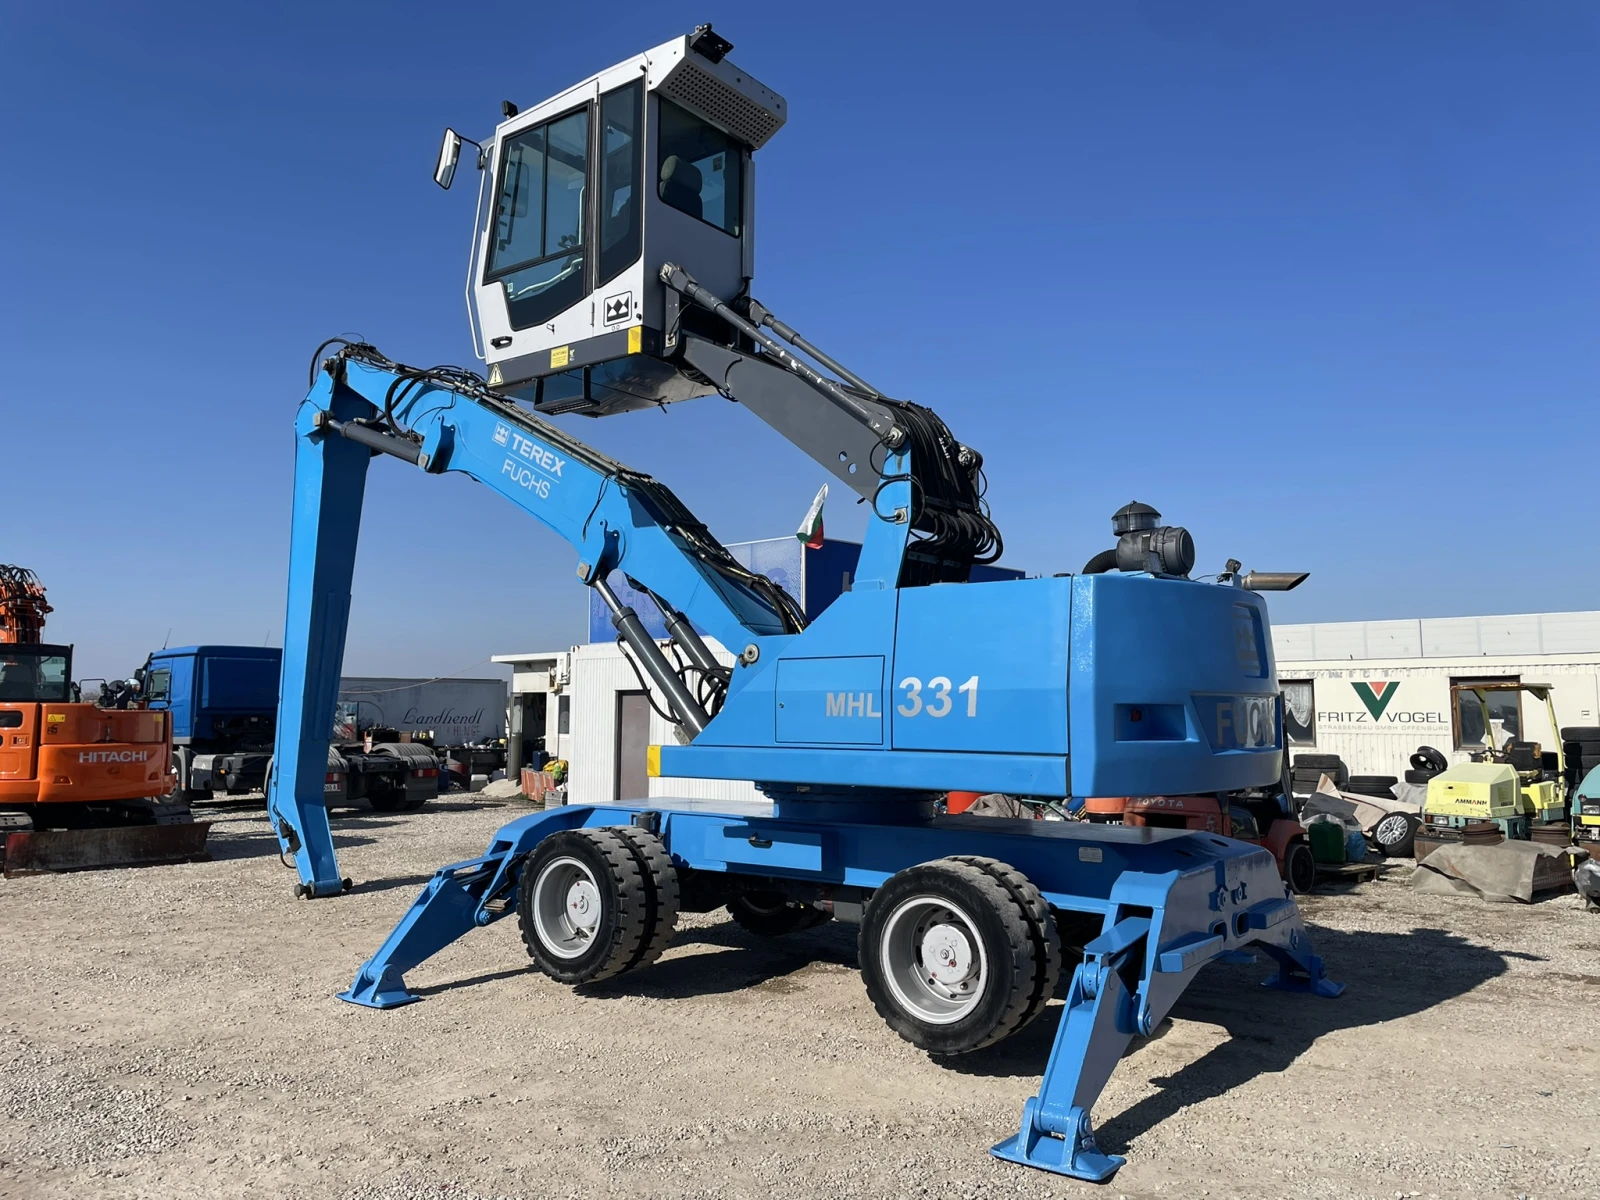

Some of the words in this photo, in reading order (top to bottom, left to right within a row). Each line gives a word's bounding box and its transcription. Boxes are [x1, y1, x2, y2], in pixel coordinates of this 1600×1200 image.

[512, 433, 566, 477] TEREX
[501, 458, 551, 499] FUCHS
[825, 692, 882, 718] MHL
[897, 675, 979, 718] 331
[401, 707, 486, 725] Landhendl
[1317, 711, 1367, 722] FRITZ
[1386, 712, 1449, 723] VOGEL
[79, 750, 148, 763] HITACHI
[1136, 798, 1184, 809] TOYOTA
[1455, 798, 1487, 806] AMMANN
